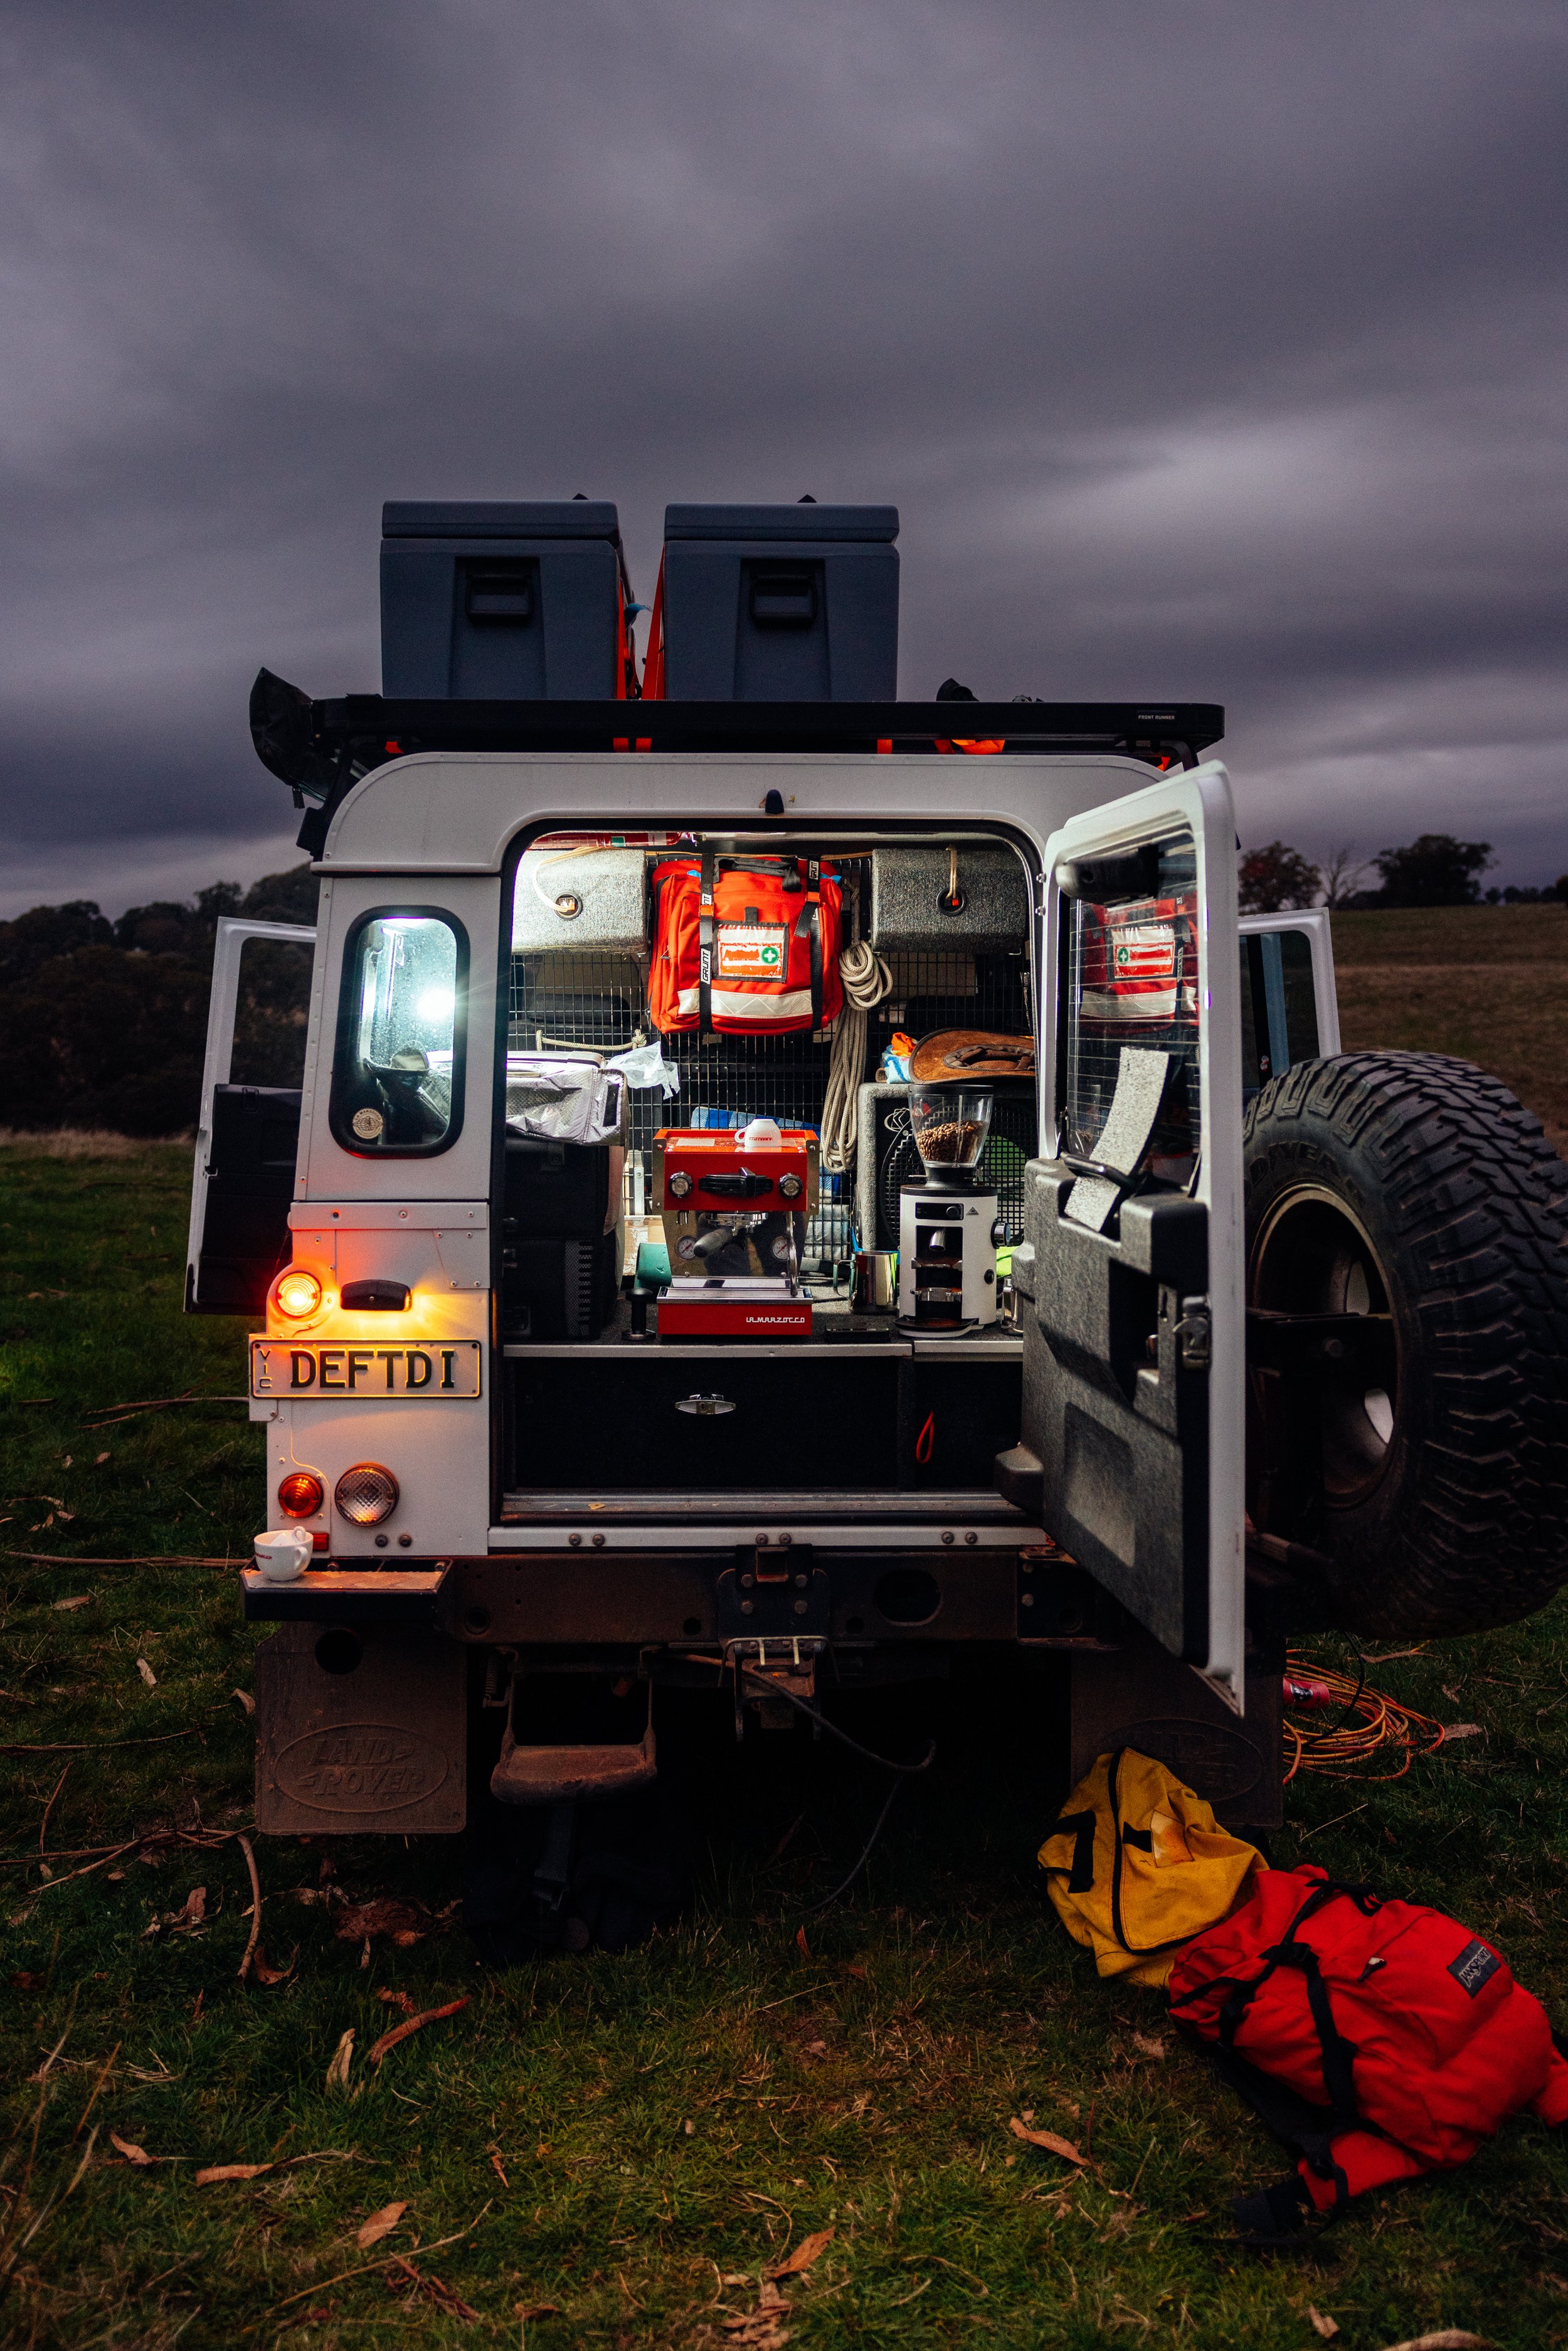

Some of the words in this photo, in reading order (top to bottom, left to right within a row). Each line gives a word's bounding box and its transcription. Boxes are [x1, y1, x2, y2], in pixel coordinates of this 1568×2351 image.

[260, 1349, 272, 1388] VIC
[290, 1349, 455, 1389] DEFTDI
[307, 1738, 394, 1766] LAND
[314, 1766, 425, 1796] ROVER
